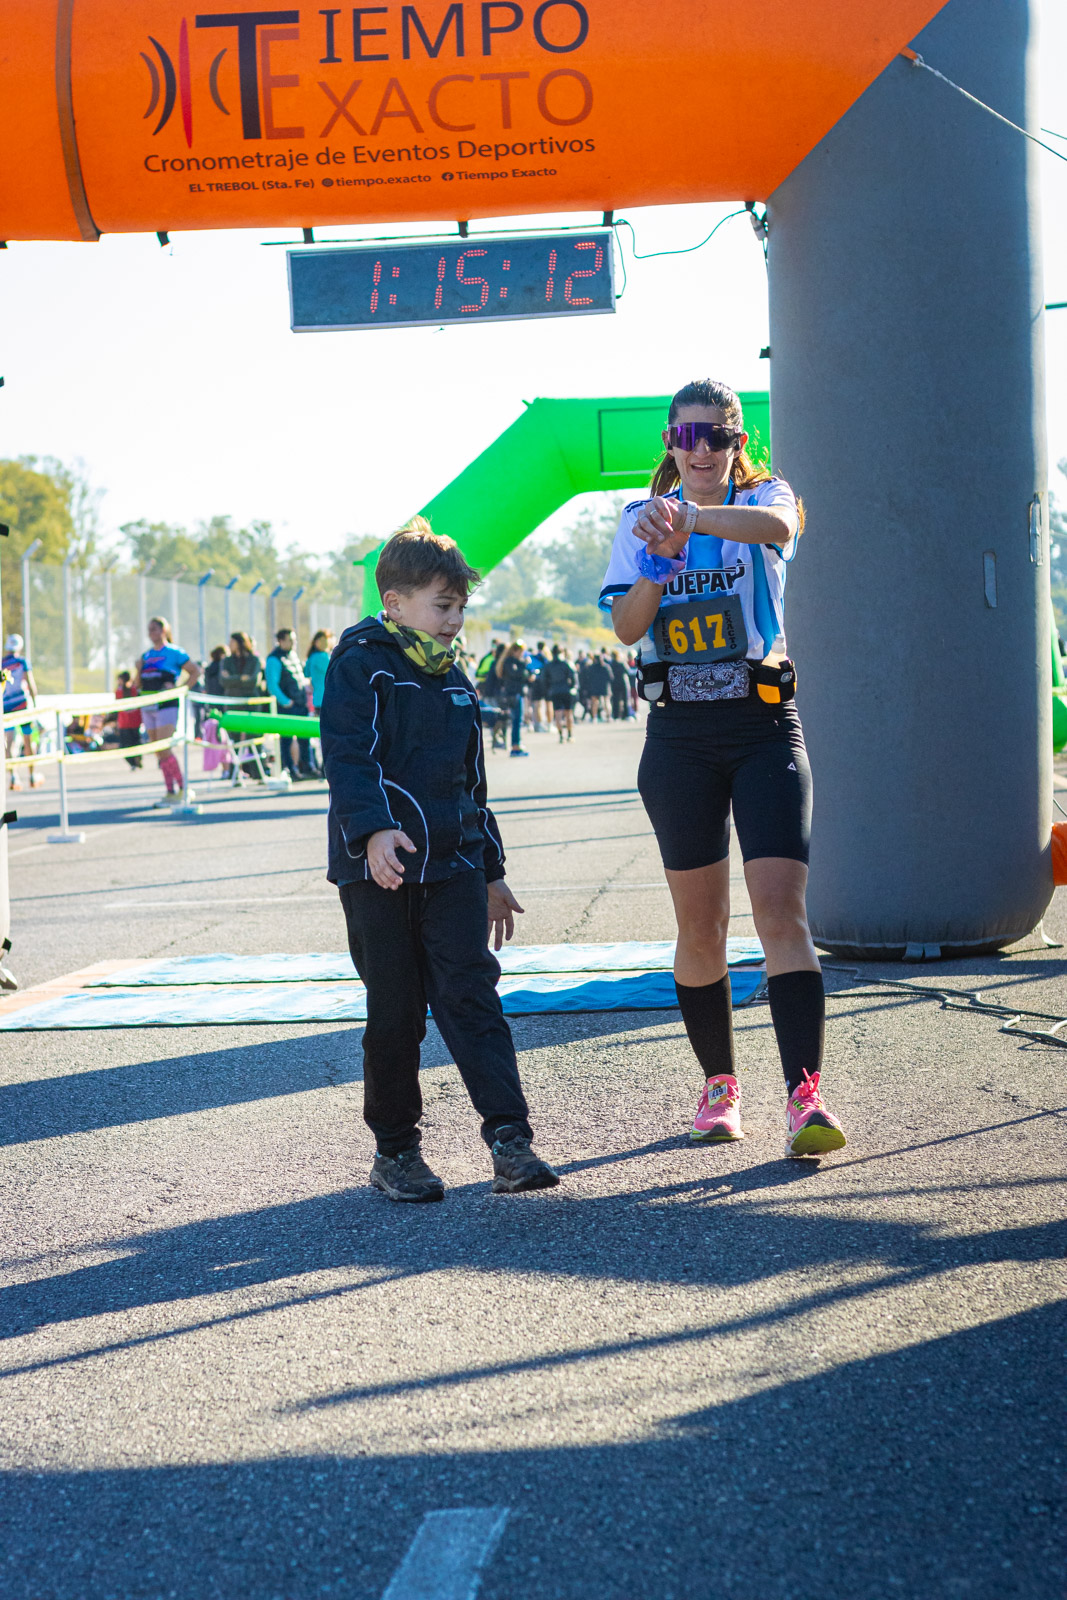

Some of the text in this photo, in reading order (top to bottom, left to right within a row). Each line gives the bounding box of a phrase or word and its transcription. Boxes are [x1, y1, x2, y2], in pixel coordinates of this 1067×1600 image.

[143, 136, 596, 173] Cronometraje de Eventos Deportivos
[335, 173, 432, 187] tiempo.exacto
[456, 167, 557, 182] Tiempo Exacto
[189, 178, 315, 193] EL TREBOL (Sta. Fe)
[668, 613, 727, 655] 617
